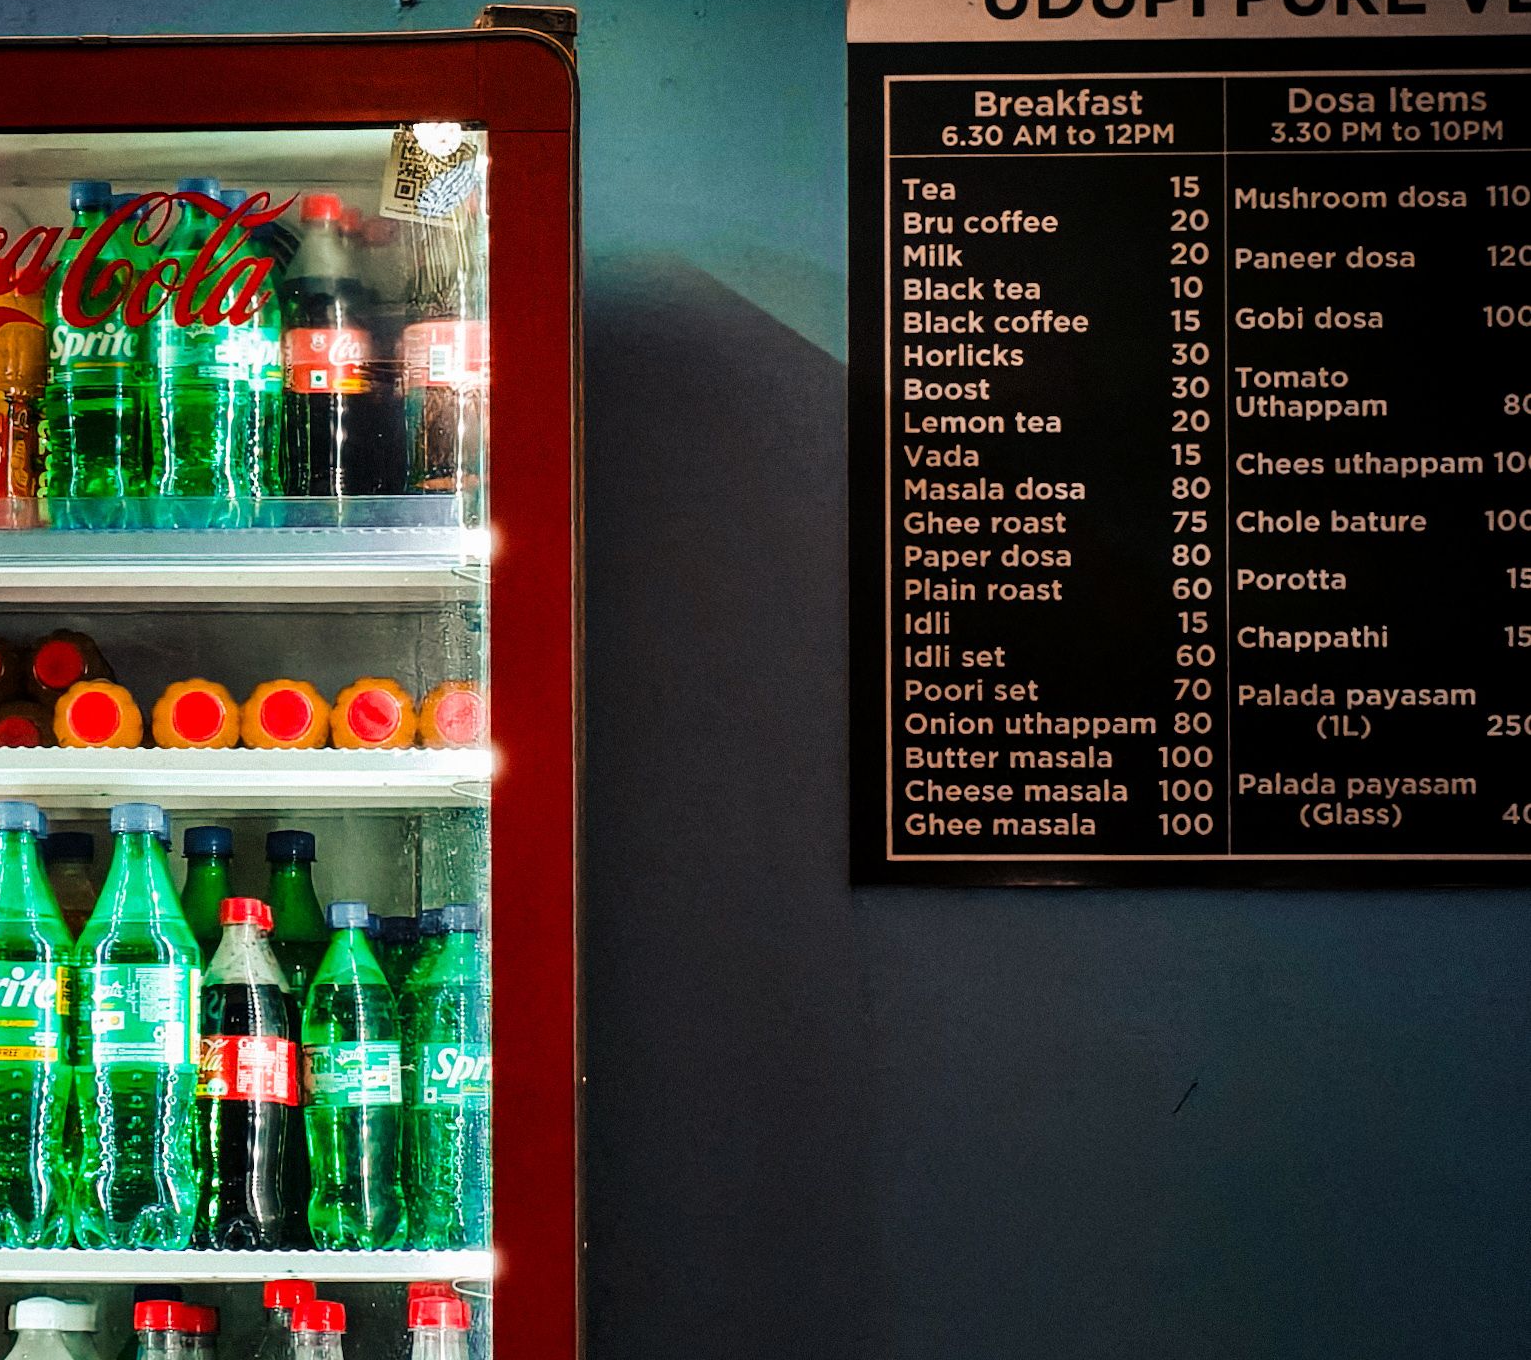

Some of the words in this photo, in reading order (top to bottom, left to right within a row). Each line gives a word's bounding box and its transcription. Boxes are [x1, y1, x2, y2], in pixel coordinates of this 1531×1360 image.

[975, 89, 1142, 116] Breakfast
[1289, 88, 1375, 113] Dosa
[1389, 86, 1487, 113] Items
[942, 125, 1004, 146] 6.30
[1013, 125, 1057, 146] AM
[1067, 125, 1096, 146] to
[1104, 124, 1174, 145] 12PM
[1271, 122, 1332, 143] 3.30
[1342, 121, 1382, 142] PM
[1392, 121, 1421, 142] to
[1430, 120, 1504, 141] 10PM
[902, 179, 956, 200] Tea
[1170, 176, 1200, 198] 15
[1235, 187, 1387, 210] Mushroom
[1398, 186, 1467, 208] dosa
[1486, 185, 1530, 207] 110
[904, 210, 953, 234] Bru
[964, 210, 1058, 234] coffee
[1171, 210, 1209, 232] 20
[904, 244, 963, 267] Milk
[1171, 243, 1209, 265] 20
[1235, 248, 1336, 270] Paneer
[1346, 246, 1415, 268] dosa
[1487, 245, 1531, 267] 120
[904, 277, 984, 300] Black
[994, 277, 1041, 300] tea
[1171, 277, 1203, 299] 10
[904, 310, 984, 333] Black
[995, 310, 1089, 333] coffee
[1171, 310, 1201, 332] 15
[1235, 307, 1304, 330] Gobi
[1315, 307, 1383, 329] dosa
[1483, 305, 1531, 328] 100
[50, 323, 139, 366] Sprite
[905, 343, 1024, 366] Horlicks
[1172, 343, 1210, 365] 30
[905, 378, 990, 400] Boost
[1172, 377, 1210, 399] 30
[1235, 367, 1349, 389] Tomato
[1235, 395, 1388, 422] Uthappam
[905, 411, 1004, 434] Lemon
[1015, 411, 1062, 434] tea
[1172, 410, 1210, 432] 20
[904, 444, 980, 467] Vada
[1171, 444, 1202, 466] 15
[1236, 453, 1325, 476] Chees
[1335, 451, 1484, 478] uthappam
[1493, 451, 1531, 473] 10
[905, 478, 1004, 500] Masala
[1015, 478, 1086, 500] dosa
[1172, 477, 1211, 499] 80
[904, 511, 980, 534] Ghee
[991, 511, 1067, 534] roast
[1173, 511, 1208, 533] 75
[1236, 510, 1321, 533] Chole
[1331, 510, 1427, 533] bature
[905, 545, 992, 571] Paper
[1001, 544, 1072, 567] dosa
[1172, 544, 1211, 566] 80
[906, 578, 976, 600] Plain
[988, 578, 1063, 600] roast
[1173, 578, 1212, 600] 60
[1237, 569, 1347, 591] Porotta
[906, 612, 950, 634] Idli
[1179, 612, 1209, 634] 15
[1237, 626, 1388, 653] Chappathi
[1504, 625, 1531, 648] 15
[906, 645, 950, 667] Idli
[962, 645, 1006, 667] set
[1177, 645, 1216, 667] 60
[906, 679, 983, 701] Poori
[995, 679, 1039, 701] set
[1174, 679, 1212, 701] 70
[1238, 684, 1335, 707] Palada
[1346, 687, 1476, 710] payasam
[905, 712, 994, 735] Onion
[1006, 712, 1157, 738] uthappam
[1174, 713, 1212, 735] 80
[1316, 715, 1371, 740] (1L)
[906, 746, 999, 768] Butter
[1010, 746, 1113, 768] masala
[1159, 746, 1213, 768] 100
[905, 779, 1014, 802] Cheese
[1025, 779, 1128, 802] masala
[1159, 780, 1213, 802] 100
[1238, 773, 1336, 795] Palada
[1347, 777, 1477, 799] payasam
[905, 813, 982, 836] Ghee
[993, 813, 1096, 836] masala
[1159, 814, 1214, 836] 100
[1300, 802, 1402, 828] (Glass)
